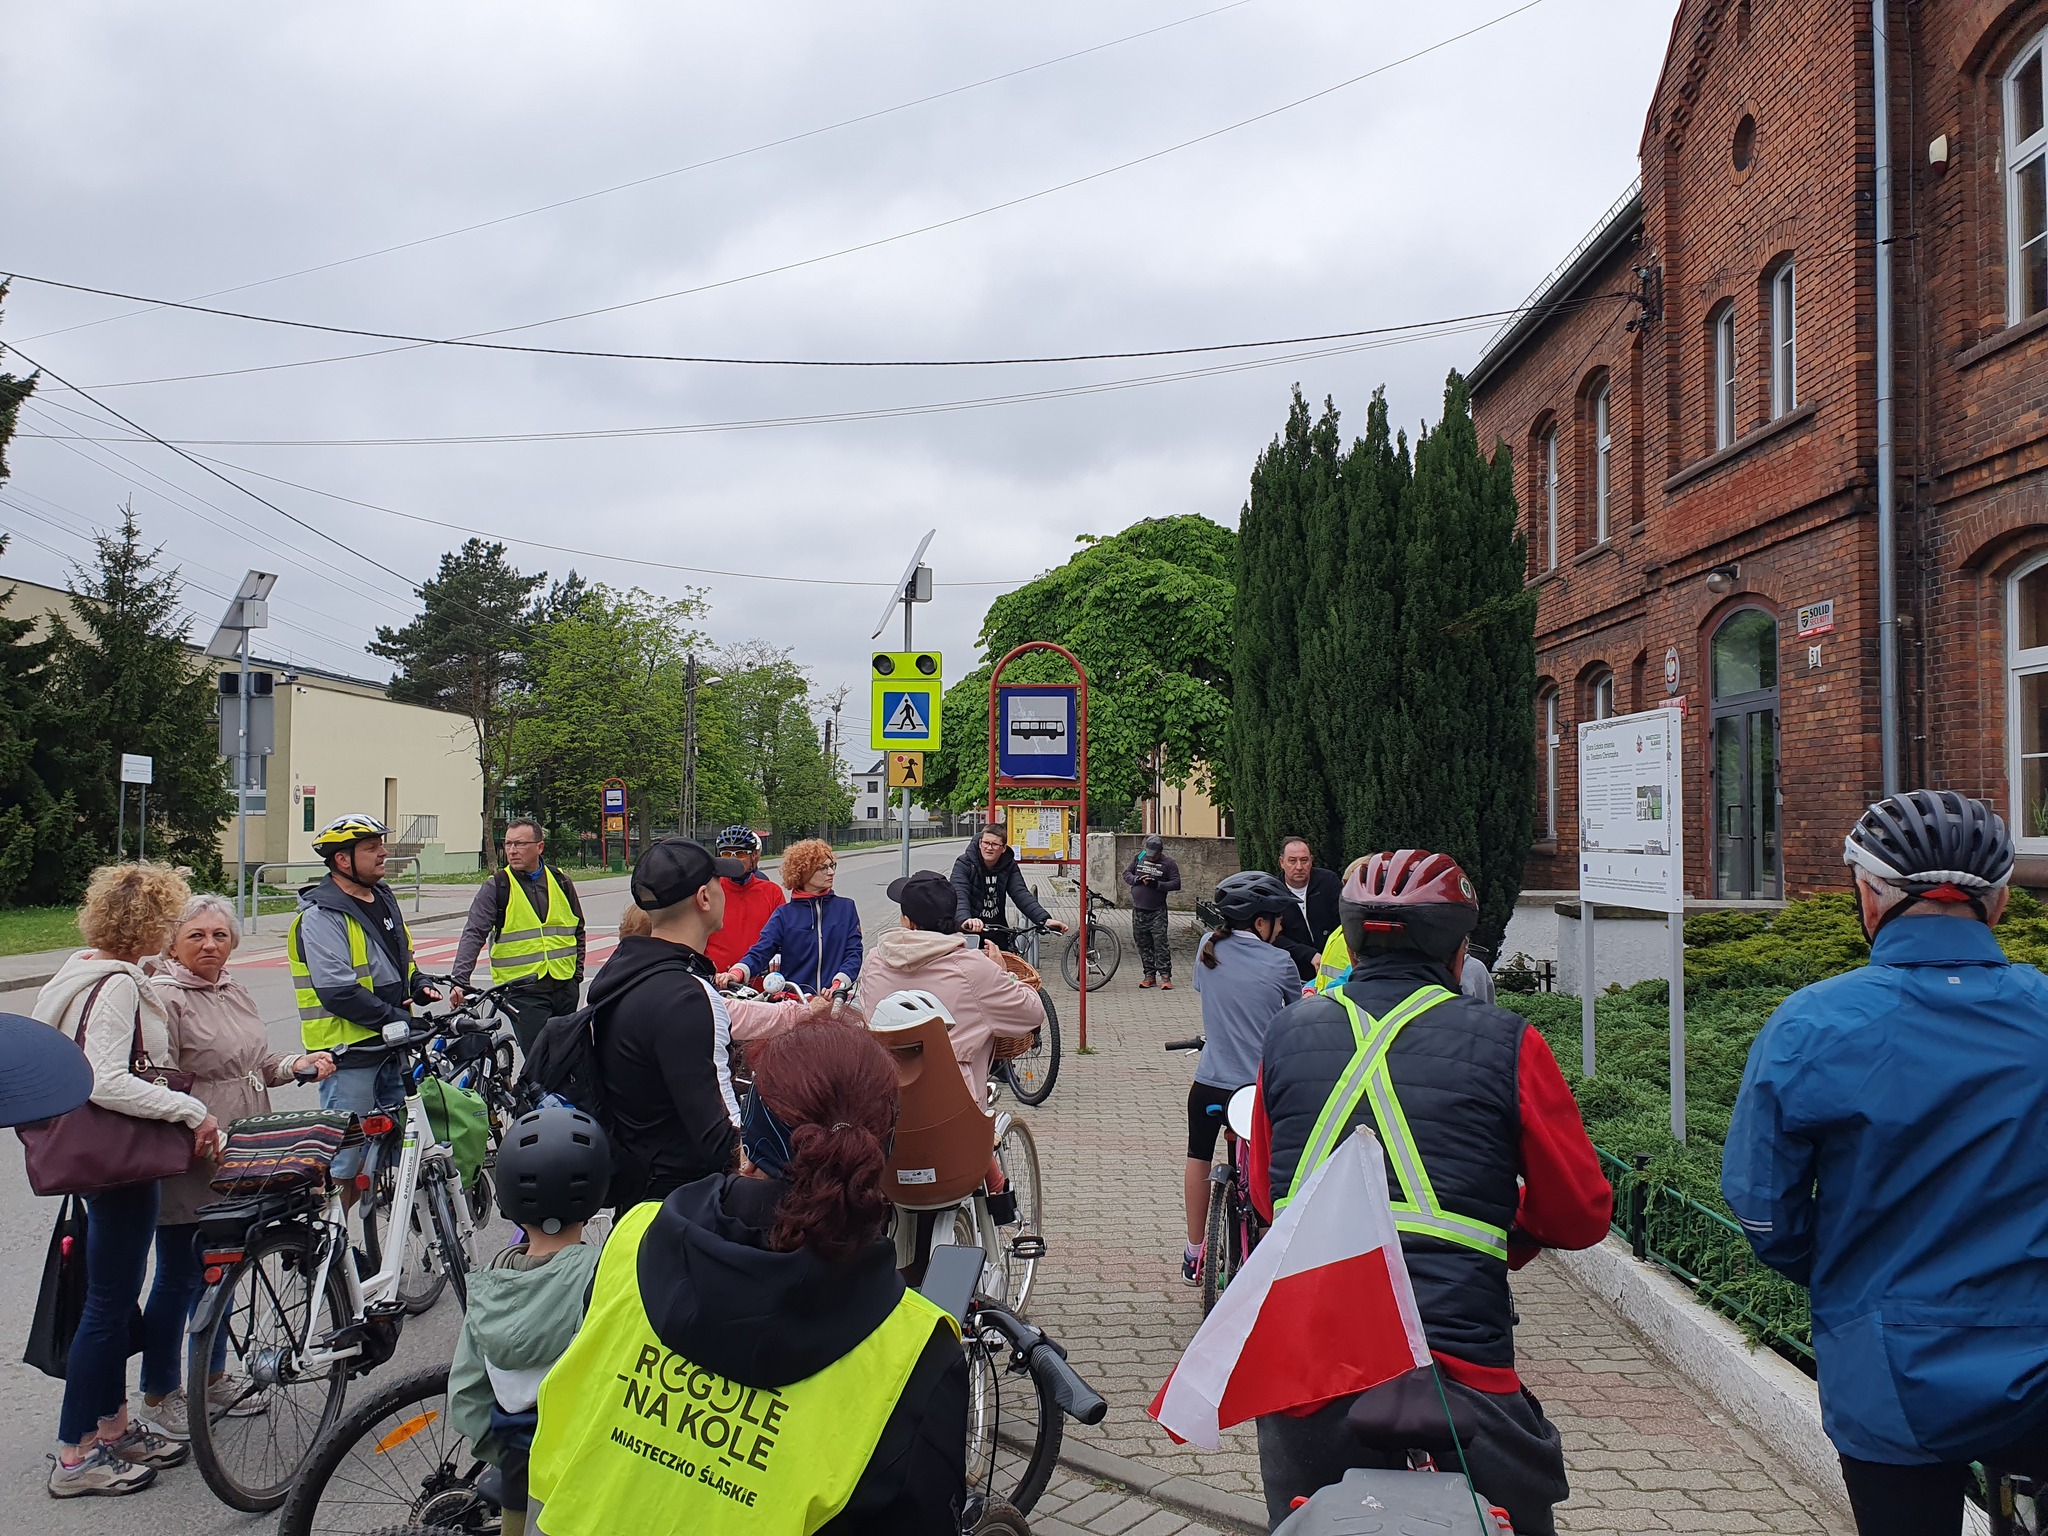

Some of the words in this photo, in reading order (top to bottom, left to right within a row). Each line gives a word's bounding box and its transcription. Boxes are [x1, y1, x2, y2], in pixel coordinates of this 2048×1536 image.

[1810, 604, 1829, 618] SOLID
[404, 1156, 413, 1194] PEGASUS
[676, 1402, 776, 1472] KOLE
